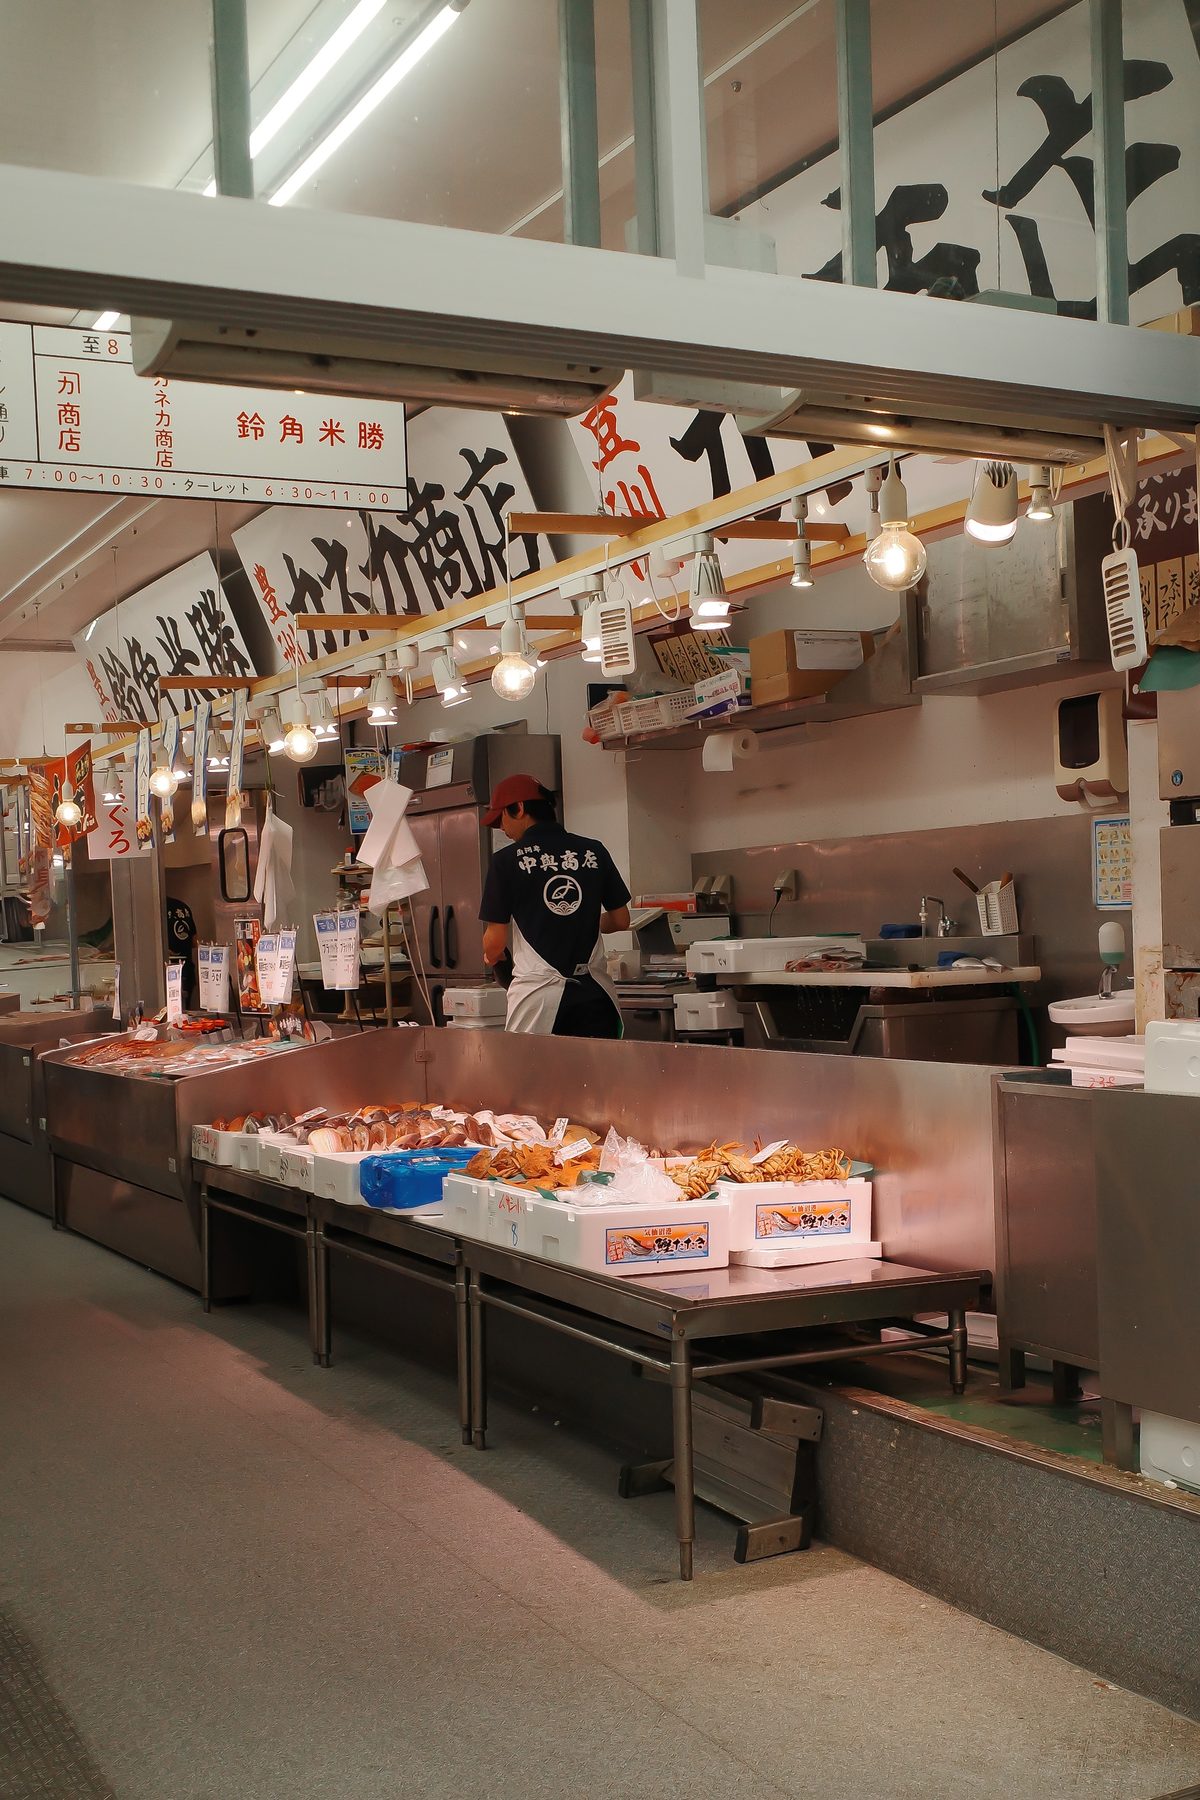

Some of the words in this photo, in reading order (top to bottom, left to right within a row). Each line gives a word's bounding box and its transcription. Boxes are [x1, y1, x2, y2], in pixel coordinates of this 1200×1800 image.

[236, 410, 386, 451] 鈴角米勝
[107, 779, 131, 855] ぐろ
